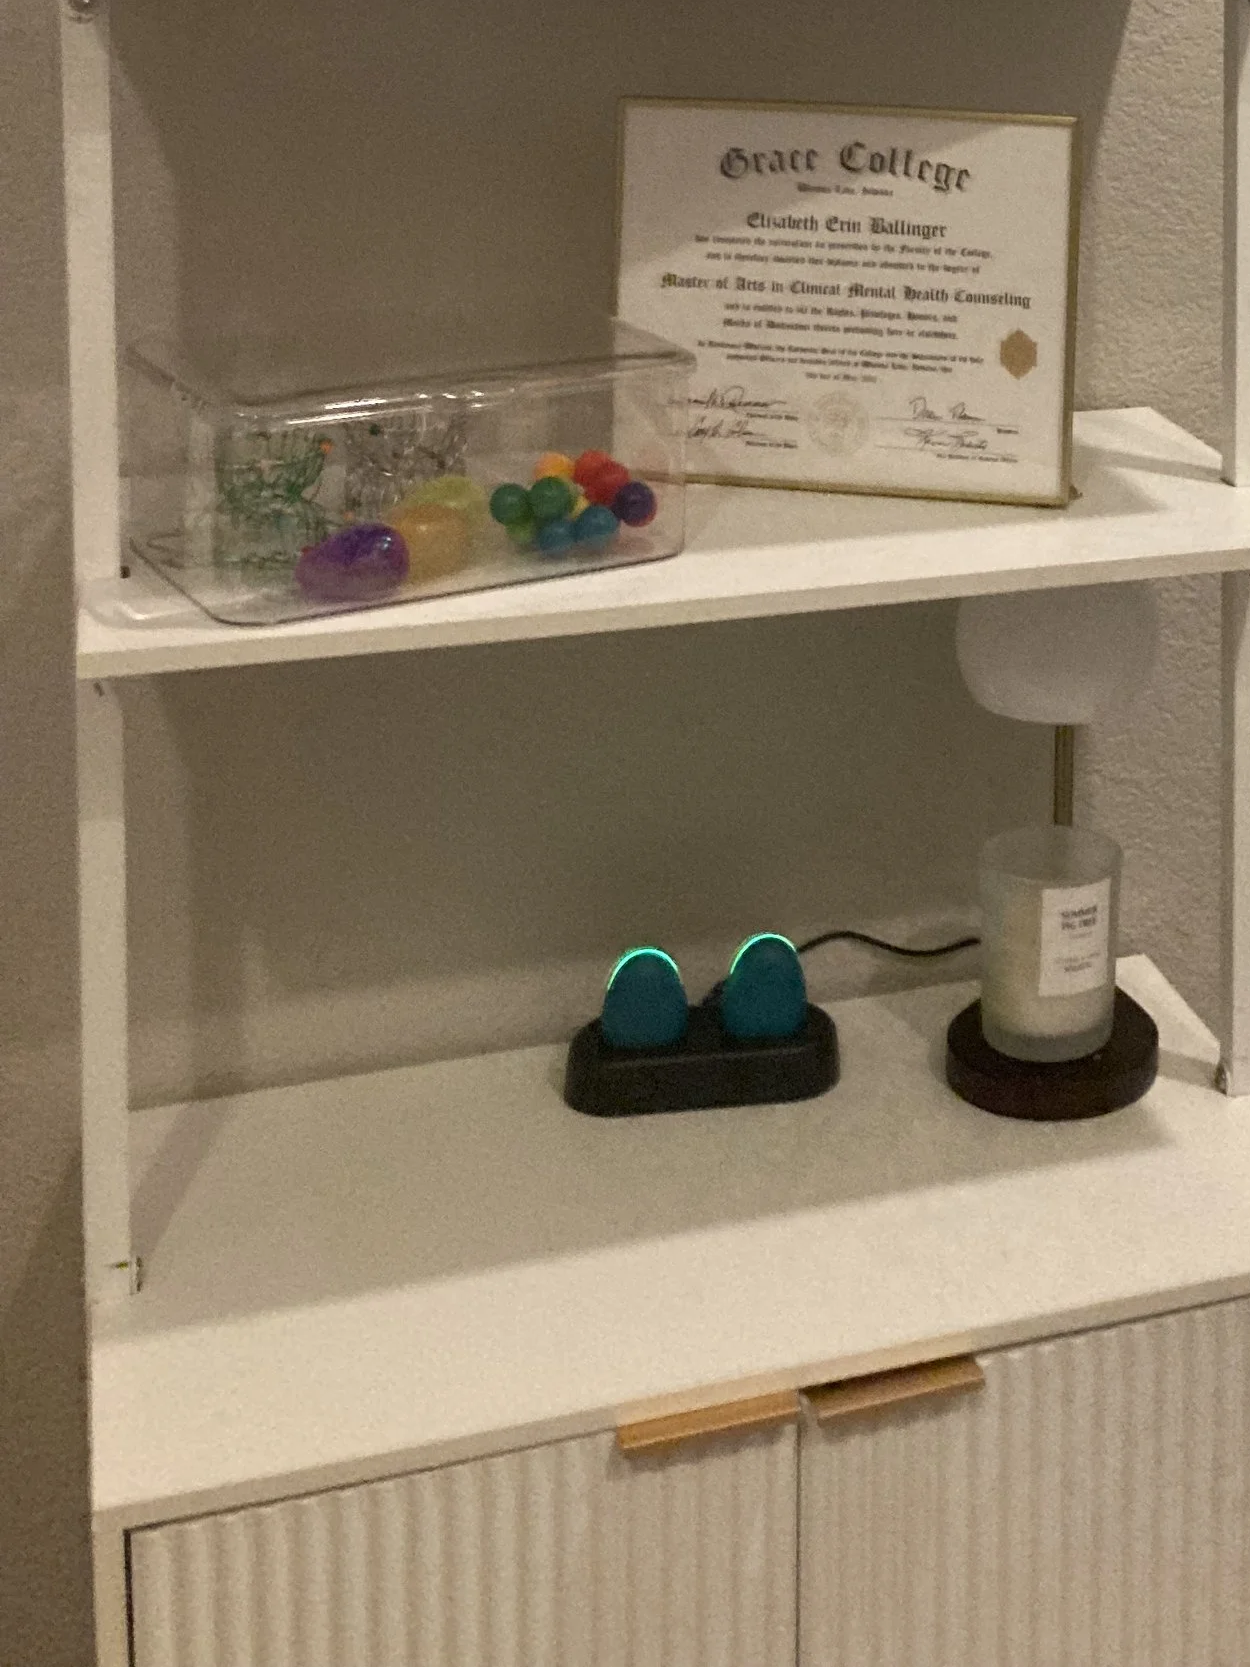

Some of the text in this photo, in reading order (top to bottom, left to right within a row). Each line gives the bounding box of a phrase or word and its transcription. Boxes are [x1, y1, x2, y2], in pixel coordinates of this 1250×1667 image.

[719, 140, 972, 195] Grace College
[825, 215, 862, 235] Erin
[869, 216, 949, 241] Ballinger
[661, 272, 1032, 311] Master of Arts in Clinical Mental Health Counseling
